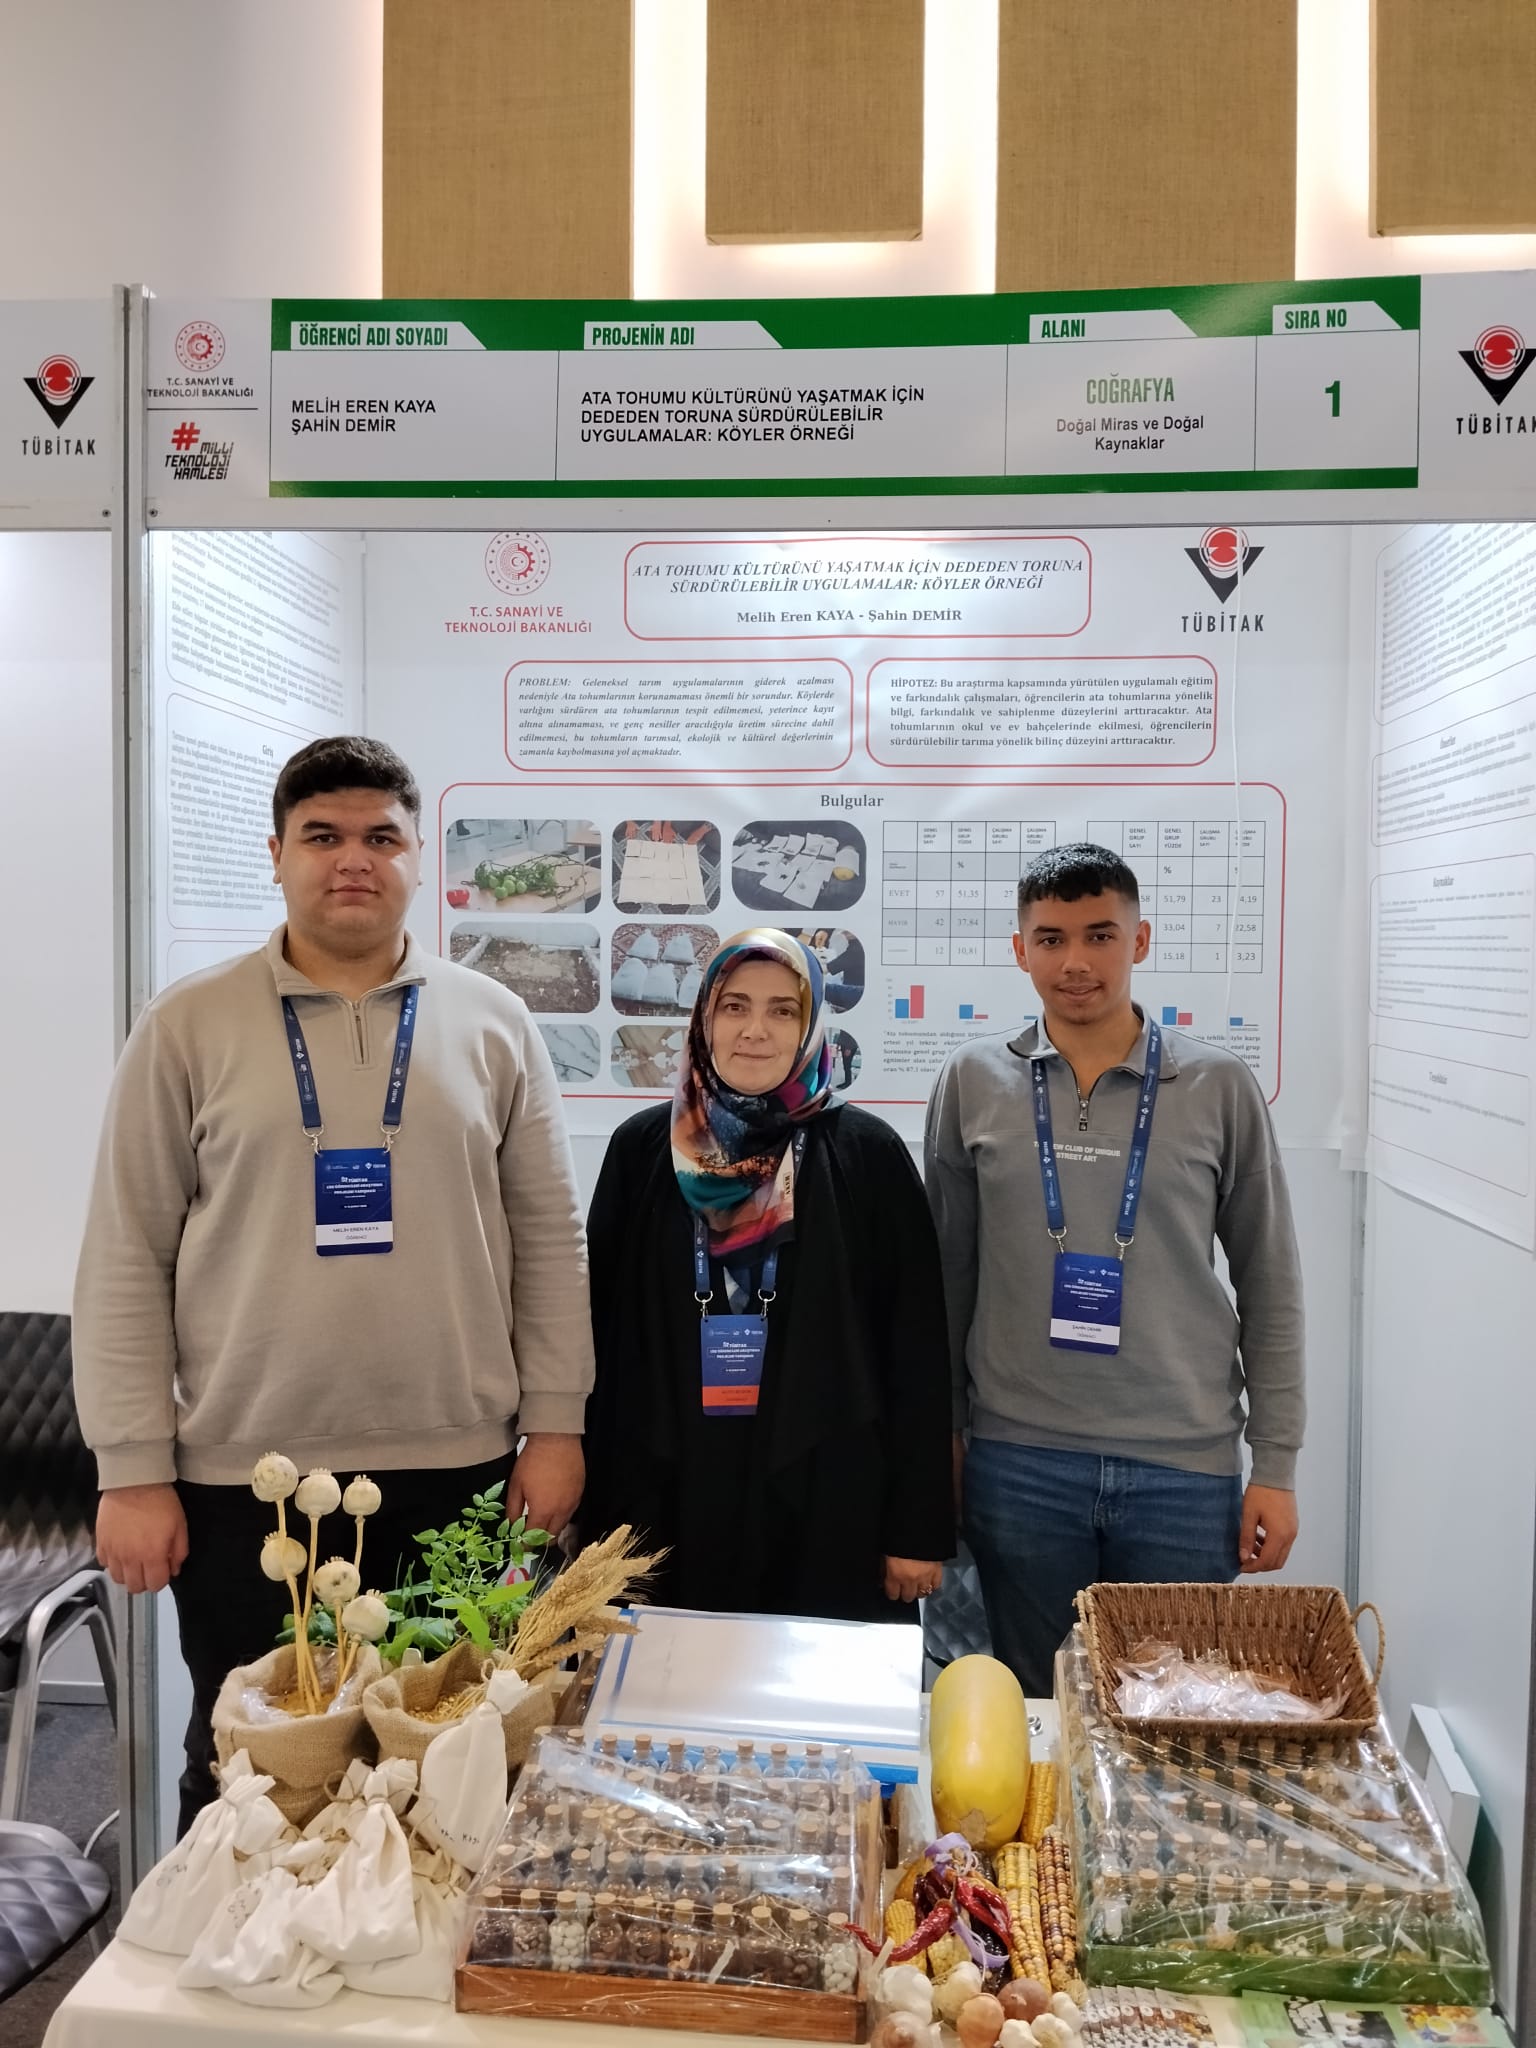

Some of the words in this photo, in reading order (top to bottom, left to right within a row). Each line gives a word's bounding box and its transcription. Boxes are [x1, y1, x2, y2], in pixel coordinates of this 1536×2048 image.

[1284, 309, 1320, 329] SIRA
[1326, 308, 1346, 327] NO
[299, 323, 361, 345] ÖĞRENCİ
[366, 327, 390, 345] ADI
[395, 327, 447, 345] SOYADI
[592, 323, 664, 345] PROJENİN
[669, 326, 694, 345] ADI
[1041, 318, 1085, 338] ALANI
[166, 377, 183, 386] T.C.
[184, 375, 219, 388] SANAYİ
[221, 377, 233, 386] VE
[1086, 373, 1174, 404] COĞRAFYA
[146, 386, 199, 398] TEKNOLOJİ
[201, 386, 253, 397] BAKANLIĞI
[581, 391, 611, 405] ATA
[616, 390, 685, 404] TOHUMU
[691, 386, 792, 404] KÜLTÜRÜNÜ
[796, 388, 887, 406] YAŞATMAK
[892, 384, 924, 405] İÇİN
[1324, 380, 1340, 417] 1
[291, 397, 339, 413] MELİH
[345, 399, 388, 413] EREN
[394, 399, 436, 413] KAYA
[581, 409, 659, 423] DEDEDEN
[664, 409, 733, 423] TORUNA
[737, 405, 883, 422] SÜRDÜRÜLEBİLİR
[291, 416, 339, 435] ŞAHİN
[345, 415, 396, 432] DEMİR
[581, 428, 711, 442] UYGULAMALAR:
[717, 424, 784, 441] KÖYLER
[789, 423, 853, 441] ÖRNEĞİ
[1056, 417, 1095, 435] Doğal
[1101, 417, 1138, 431] Miras
[1142, 419, 1159, 430] ve
[1163, 415, 1203, 432] Doğal
[21, 438, 96, 456] TÜBİTAK
[1095, 435, 1165, 453] Kaynaklar
[164, 455, 232, 468] TEKNOLOJİ
[173, 467, 228, 481] HAMLESİ
[632, 565, 659, 576] ATA
[665, 563, 729, 577] TOHUMU
[732, 559, 822, 577] KÜLTÜRÜNÜ
[827, 560, 904, 575] YAŞATMAK
[907, 558, 941, 574] İÇİN
[943, 560, 1018, 573] DEDEDEN
[1022, 559, 1082, 572] TORUNA
[670, 576, 798, 592] SÜRDÜRÜLEBİLİR
[802, 577, 918, 591] UYGULAMALAR:
[921, 575, 980, 590] KÖYLER
[984, 574, 1043, 589] ÖRNEĞİ
[469, 606, 492, 617] T.C.
[495, 604, 542, 617] SANAYİ
[546, 606, 563, 617] VE
[737, 611, 775, 622] Melih
[780, 611, 811, 622] Eren
[816, 609, 854, 621] KAYA
[868, 609, 907, 622] Şahin
[911, 608, 962, 621] DEMİR
[444, 620, 516, 632] TEKNOLOJİ
[520, 620, 591, 633] BAKANLIĞI
[1181, 612, 1264, 632] TÜBİTAK
[890, 676, 937, 687] HİPOTEZ:
[940, 678, 953, 687] Bu
[955, 679, 1004, 689] araştırma
[1007, 677, 1067, 689] kapsamında
[1069, 677, 1119, 689] yürütülen
[1122, 676, 1177, 688] uygulamalı
[1180, 676, 1212, 687] eğitim
[905, 692, 960, 702] farkındalık
[963, 692, 1020, 704] çalışmaları,
[1024, 692, 1085, 704] öğrencilerin
[1088, 693, 1104, 701] ata
[1108, 691, 1170, 701] tohumlarına
[1174, 690, 1212, 702] yönelik
[890, 706, 914, 718] bilgi,
[920, 707, 974, 716] farkındalık
[998, 707, 1055, 718] sahiplenme
[1061, 706, 1117, 717] düzeylerini
[1123, 705, 1189, 715] arttıracaktır.
[1195, 705, 1212, 714] Ata
[890, 721, 954, 731] tohumlarının
[961, 721, 983, 731] okul
[1026, 721, 1091, 732] bahçelerinde
[1098, 721, 1143, 731] ekilmesi,
[1150, 720, 1212, 731] öğrencilerin
[890, 736, 959, 746] sürdürülebilir
[961, 738, 994, 746] tarıma
[996, 736, 1033, 748] yönelik
[1035, 736, 1063, 747] bilinç
[1065, 735, 1108, 747] düzeyini
[1110, 735, 1175, 745] arttıracaktır.
[820, 793, 884, 810] Bulgular
[1084, 1146, 1095, 1154] OF
